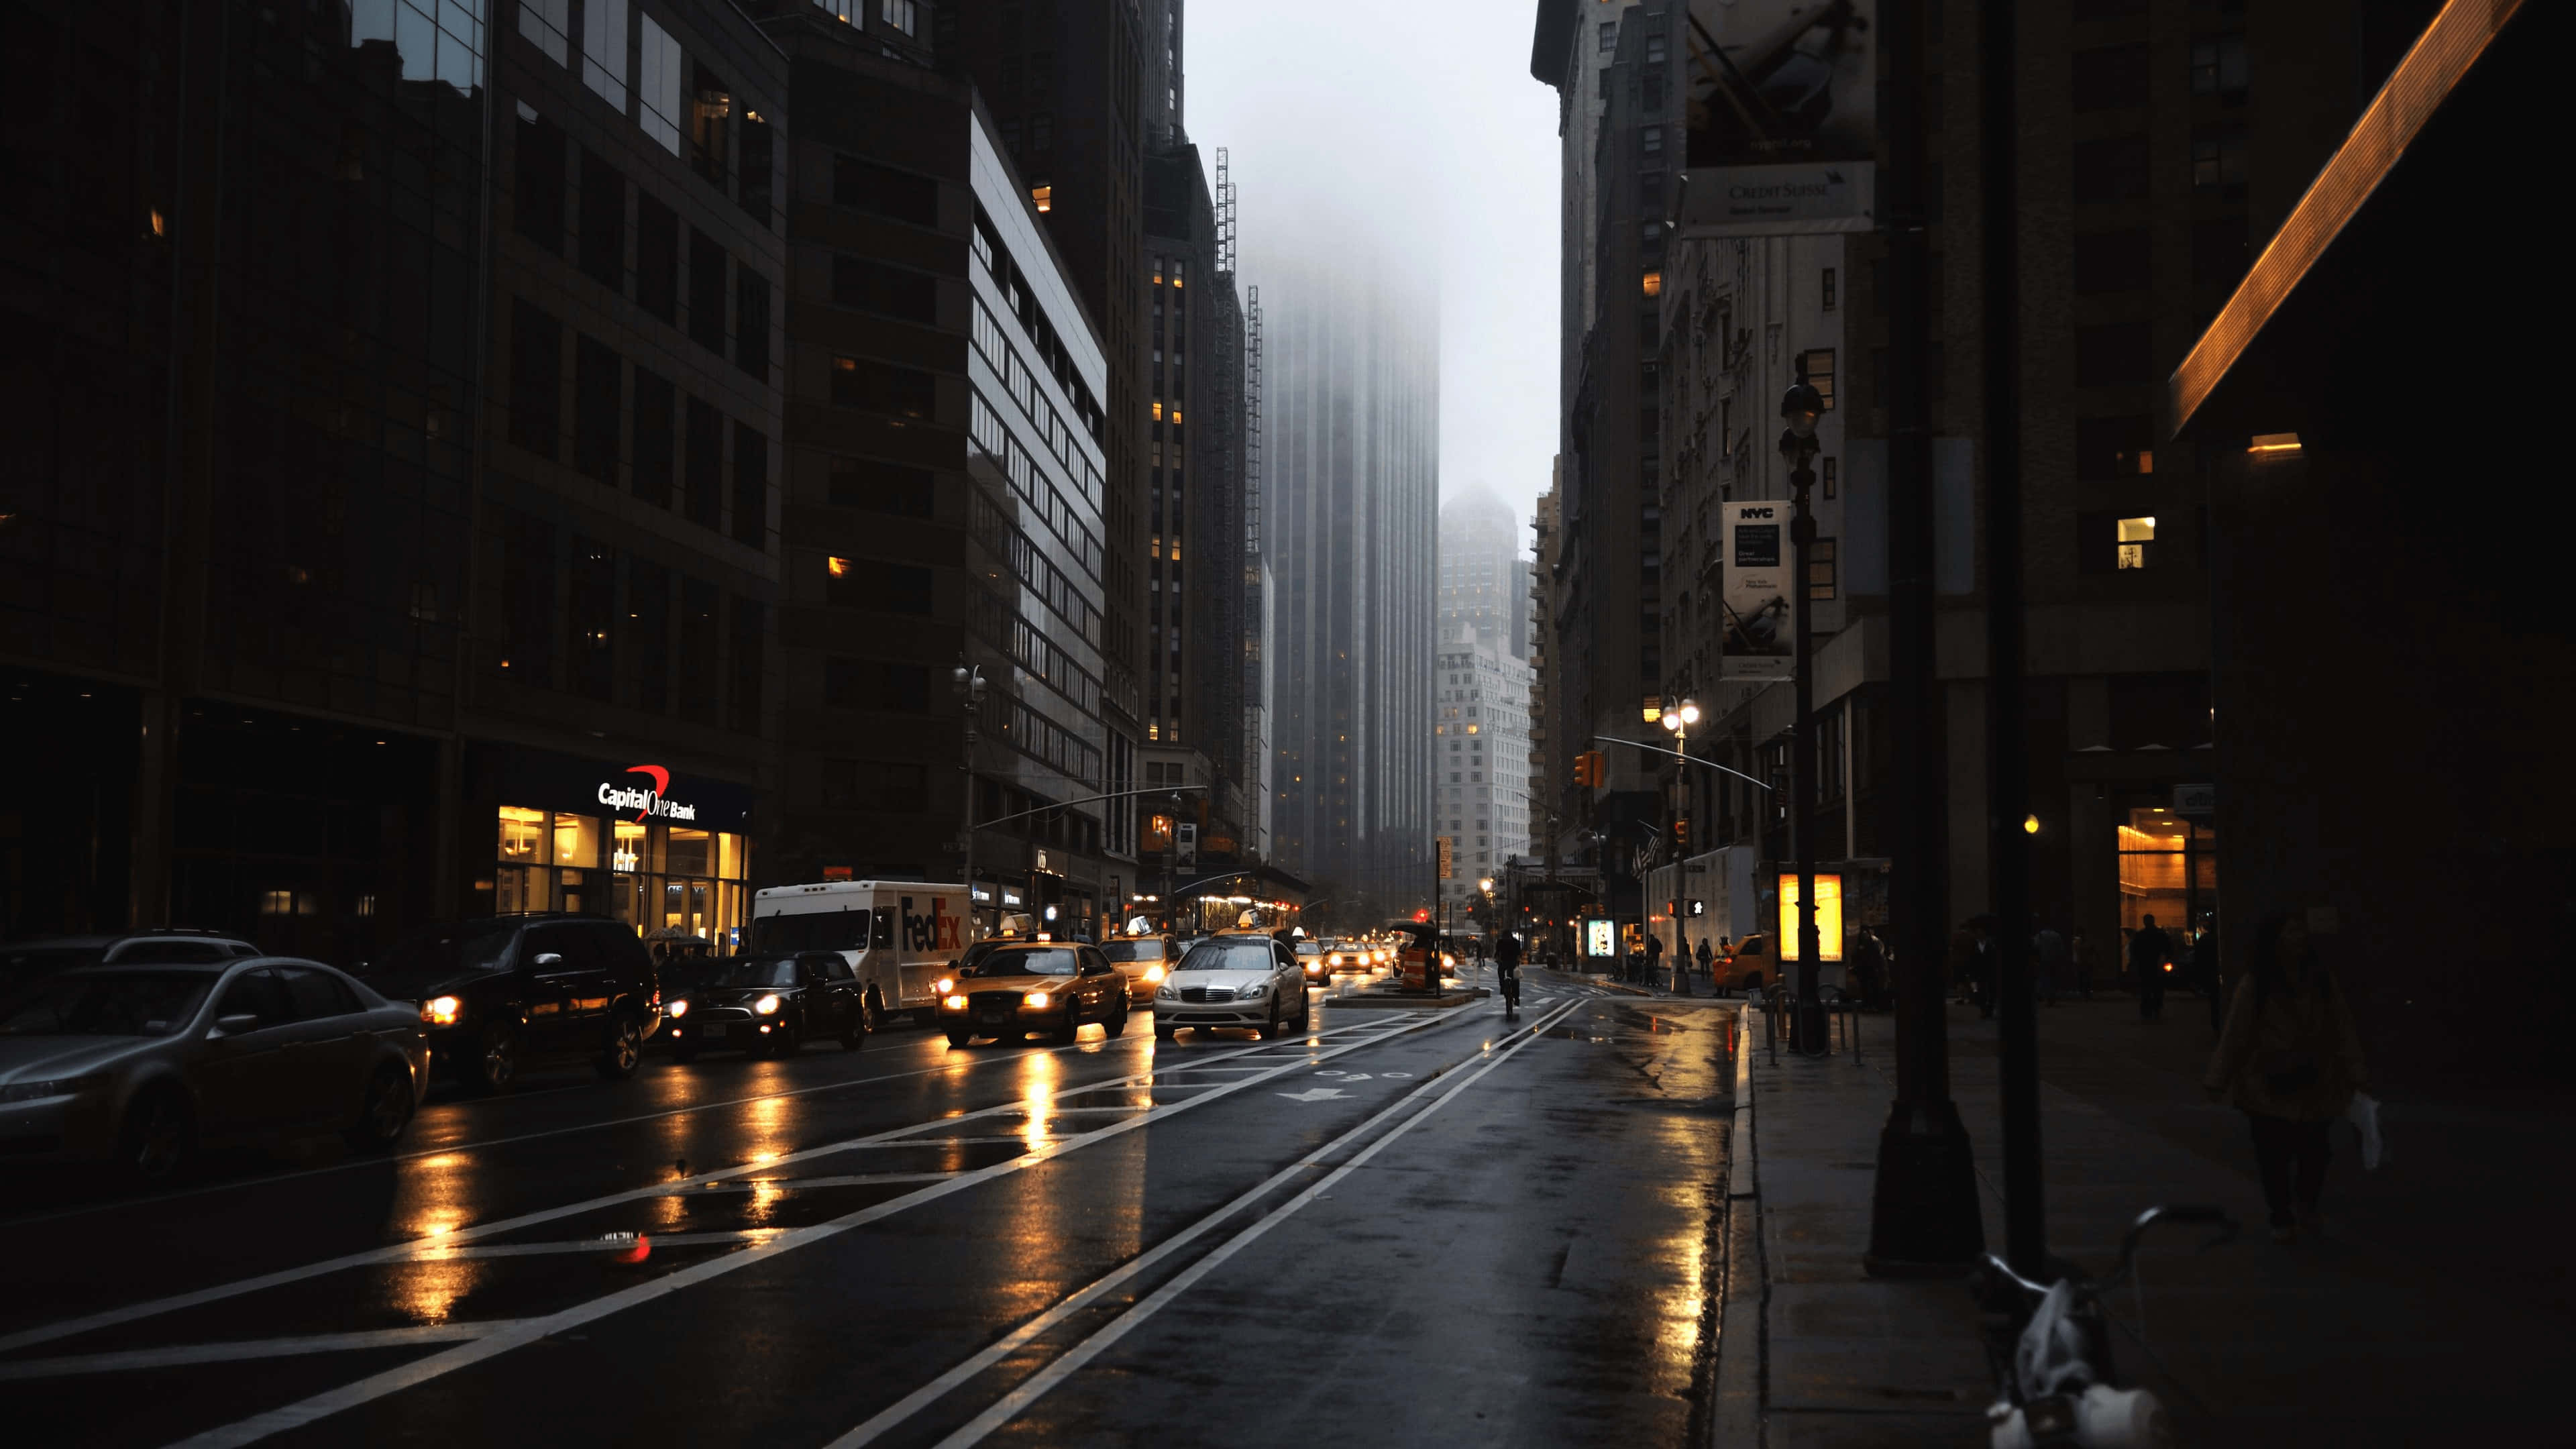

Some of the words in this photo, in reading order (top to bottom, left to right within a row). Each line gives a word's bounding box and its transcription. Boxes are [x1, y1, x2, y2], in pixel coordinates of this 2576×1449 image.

[1741, 508, 1773, 519] NYC
[669, 802, 695, 820] Bank
[901, 896, 962, 952] FedEx
